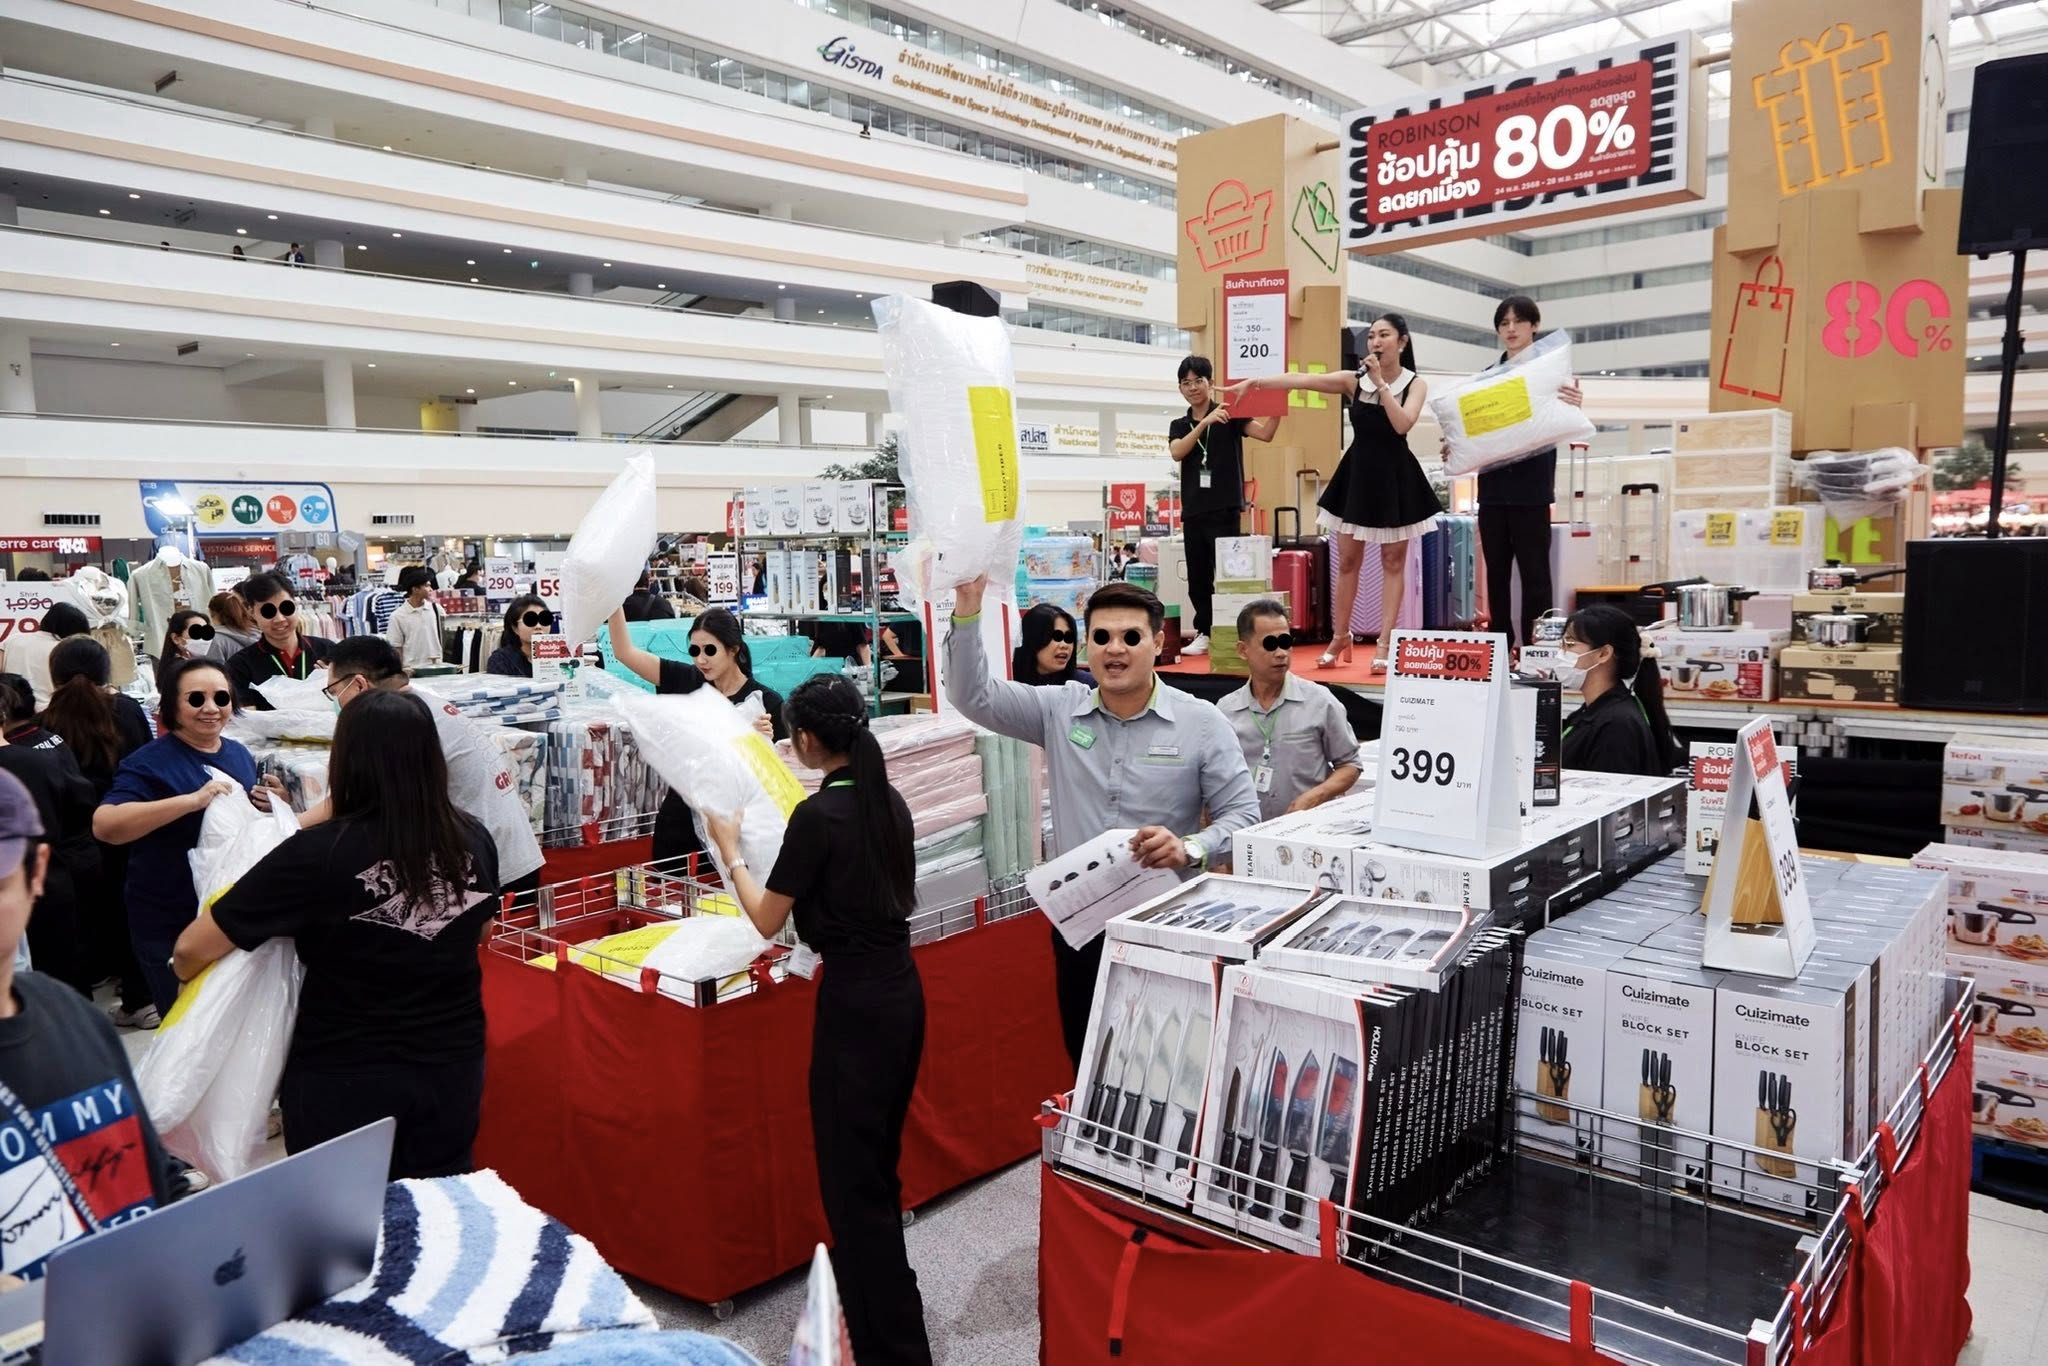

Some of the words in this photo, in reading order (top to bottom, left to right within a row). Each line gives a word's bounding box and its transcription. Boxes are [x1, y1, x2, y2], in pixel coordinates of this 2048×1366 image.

[892, 74, 951, 100] Geo-Informatics
[967, 97, 990, 114] Space
[991, 106, 1031, 128] Technology
[1030, 119, 1072, 139] Development
[1589, 90, 1635, 109] ลดสูงสุด
[1378, 112, 1480, 149] ROBINSON
[1493, 104, 1636, 179] 80%
[1377, 138, 1480, 186] ช้อปคุ้ม
[1378, 177, 1480, 214] ลดยกเมือง
[1494, 185, 1505, 195] 24
[1226, 278, 1285, 290] สินค้านาทีทอง
[1822, 278, 1952, 359] 80%
[1246, 325, 1261, 333] 350
[1240, 344, 1269, 359] 200
[1058, 438, 1098, 448] National
[1114, 511, 1142, 520] TORA
[1146, 524, 1169, 532] CENTRAL
[488, 577, 514, 590] 290
[714, 582, 733, 594] 199
[1405, 643, 1445, 662] ช้อปคุ้ม
[1445, 653, 1482, 671] 80%
[1525, 650, 1549, 658] MEYER
[1404, 661, 1444, 670] ลดยกเมือง
[1400, 697, 1435, 706] CUIZIMATE
[1950, 752, 1983, 761] Tefal
[1391, 747, 1455, 786] 399
[1456, 781, 1472, 789] บาท
[1952, 827, 1984, 837] Tefal
[1522, 966, 1584, 986] Cuizimate
[1622, 985, 1690, 1007] Cuizimate
[1522, 998, 1558, 1013] BLOCK
[1562, 1007, 1583, 1018] SET
[1735, 1005, 1810, 1027] Cuizimate
[1622, 1019, 1662, 1034] BLOCK
[1667, 1028, 1689, 1039] SET
[1735, 1040, 1779, 1055] BLOCK
[1785, 1049, 1810, 1060] SET
[1417, 1119, 1426, 1163] STAINLESS
[1428, 1114, 1436, 1157] STAINLESS
[1390, 1139, 1399, 1185] STAINLESS
[1401, 1132, 1411, 1178] STAINLESS
[1367, 1153, 1378, 1199] STAINLESS
[1378, 1145, 1388, 1191] STAINLESS
[1689, 1167, 1700, 1178] 7
